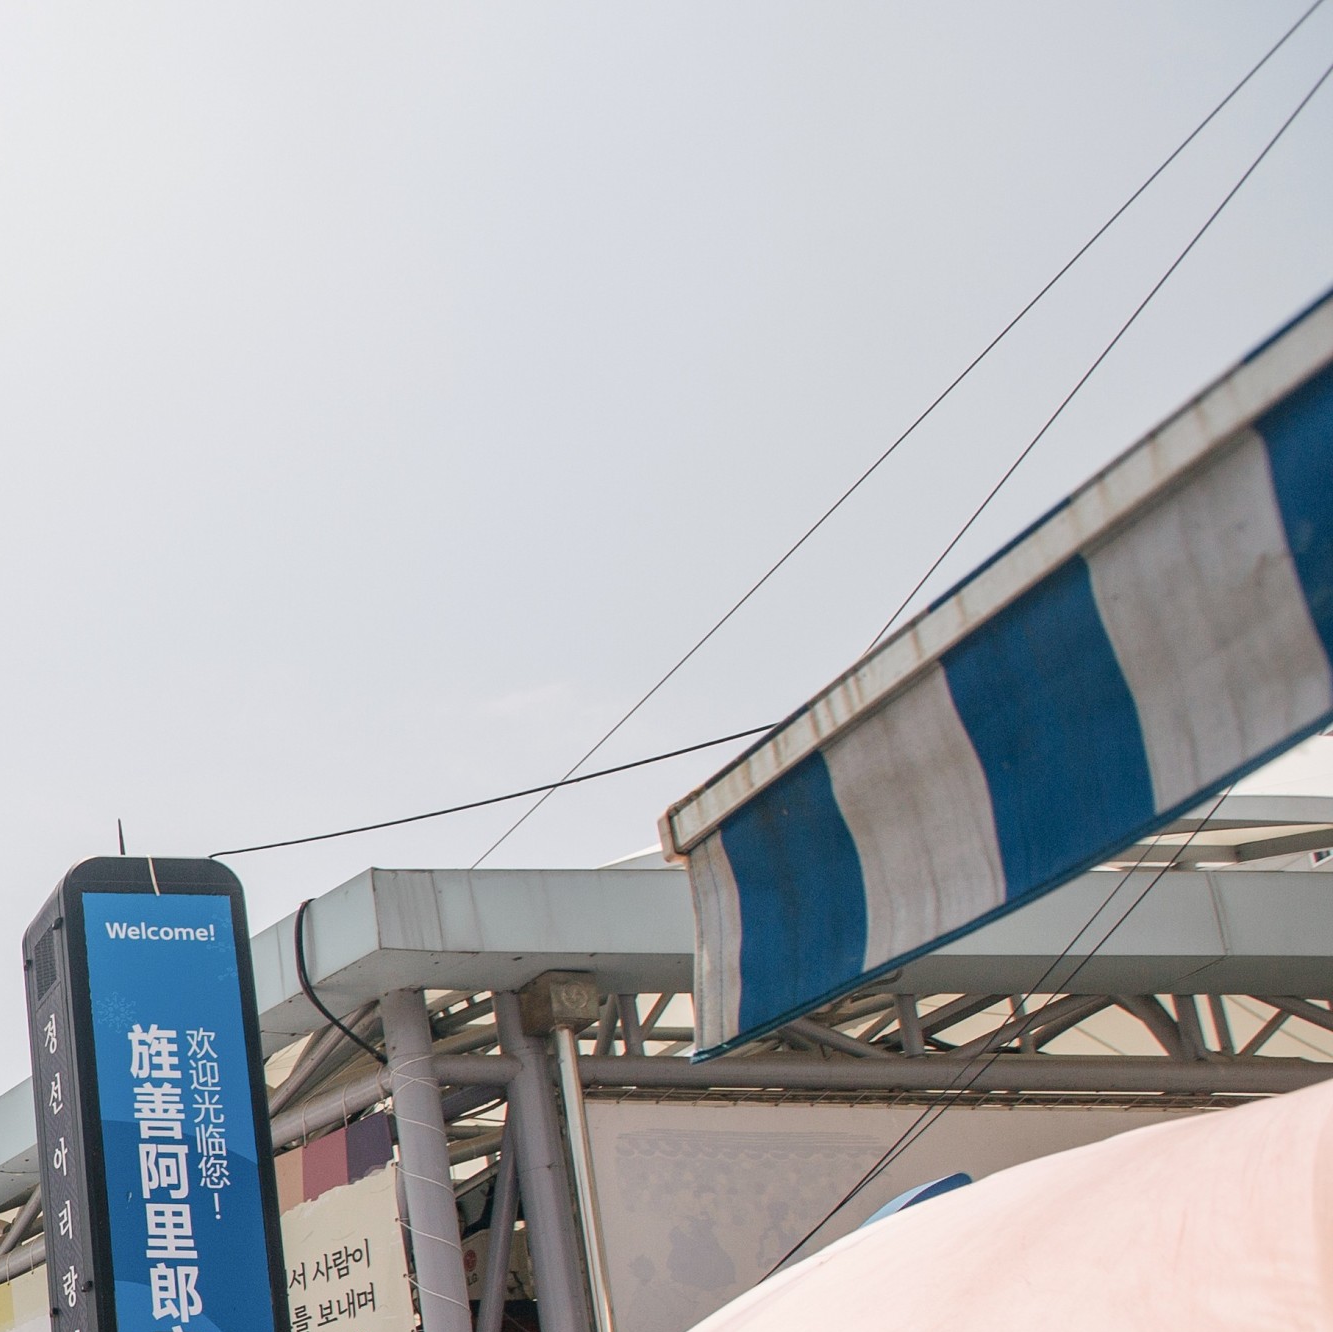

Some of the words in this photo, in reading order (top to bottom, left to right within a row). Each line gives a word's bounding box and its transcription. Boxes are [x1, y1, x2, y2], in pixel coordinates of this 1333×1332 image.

[106, 922, 216, 942] Welcome!
[288, 1262, 307, 1291] 서
[312, 1238, 371, 1283] 사람이
[317, 1282, 376, 1327] 보내며
